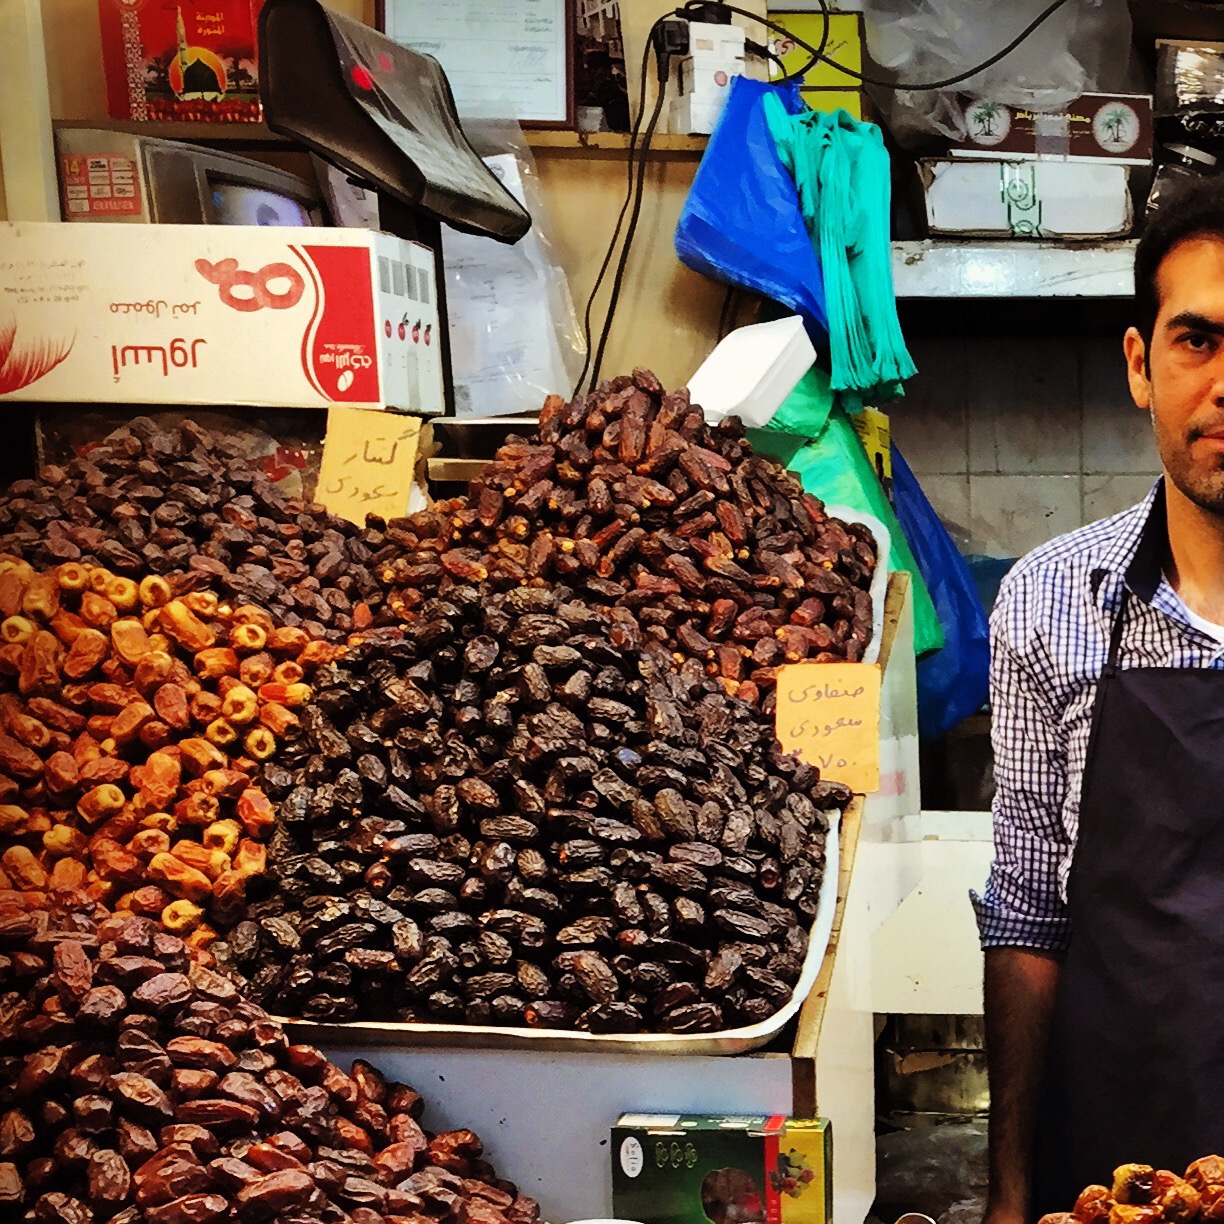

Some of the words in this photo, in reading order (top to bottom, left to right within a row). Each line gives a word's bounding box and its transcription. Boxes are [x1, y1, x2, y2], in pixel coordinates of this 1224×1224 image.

[109, 300, 168, 319] معمول
[172, 300, 202, 320] تمر
[111, 337, 208, 384] أساور
